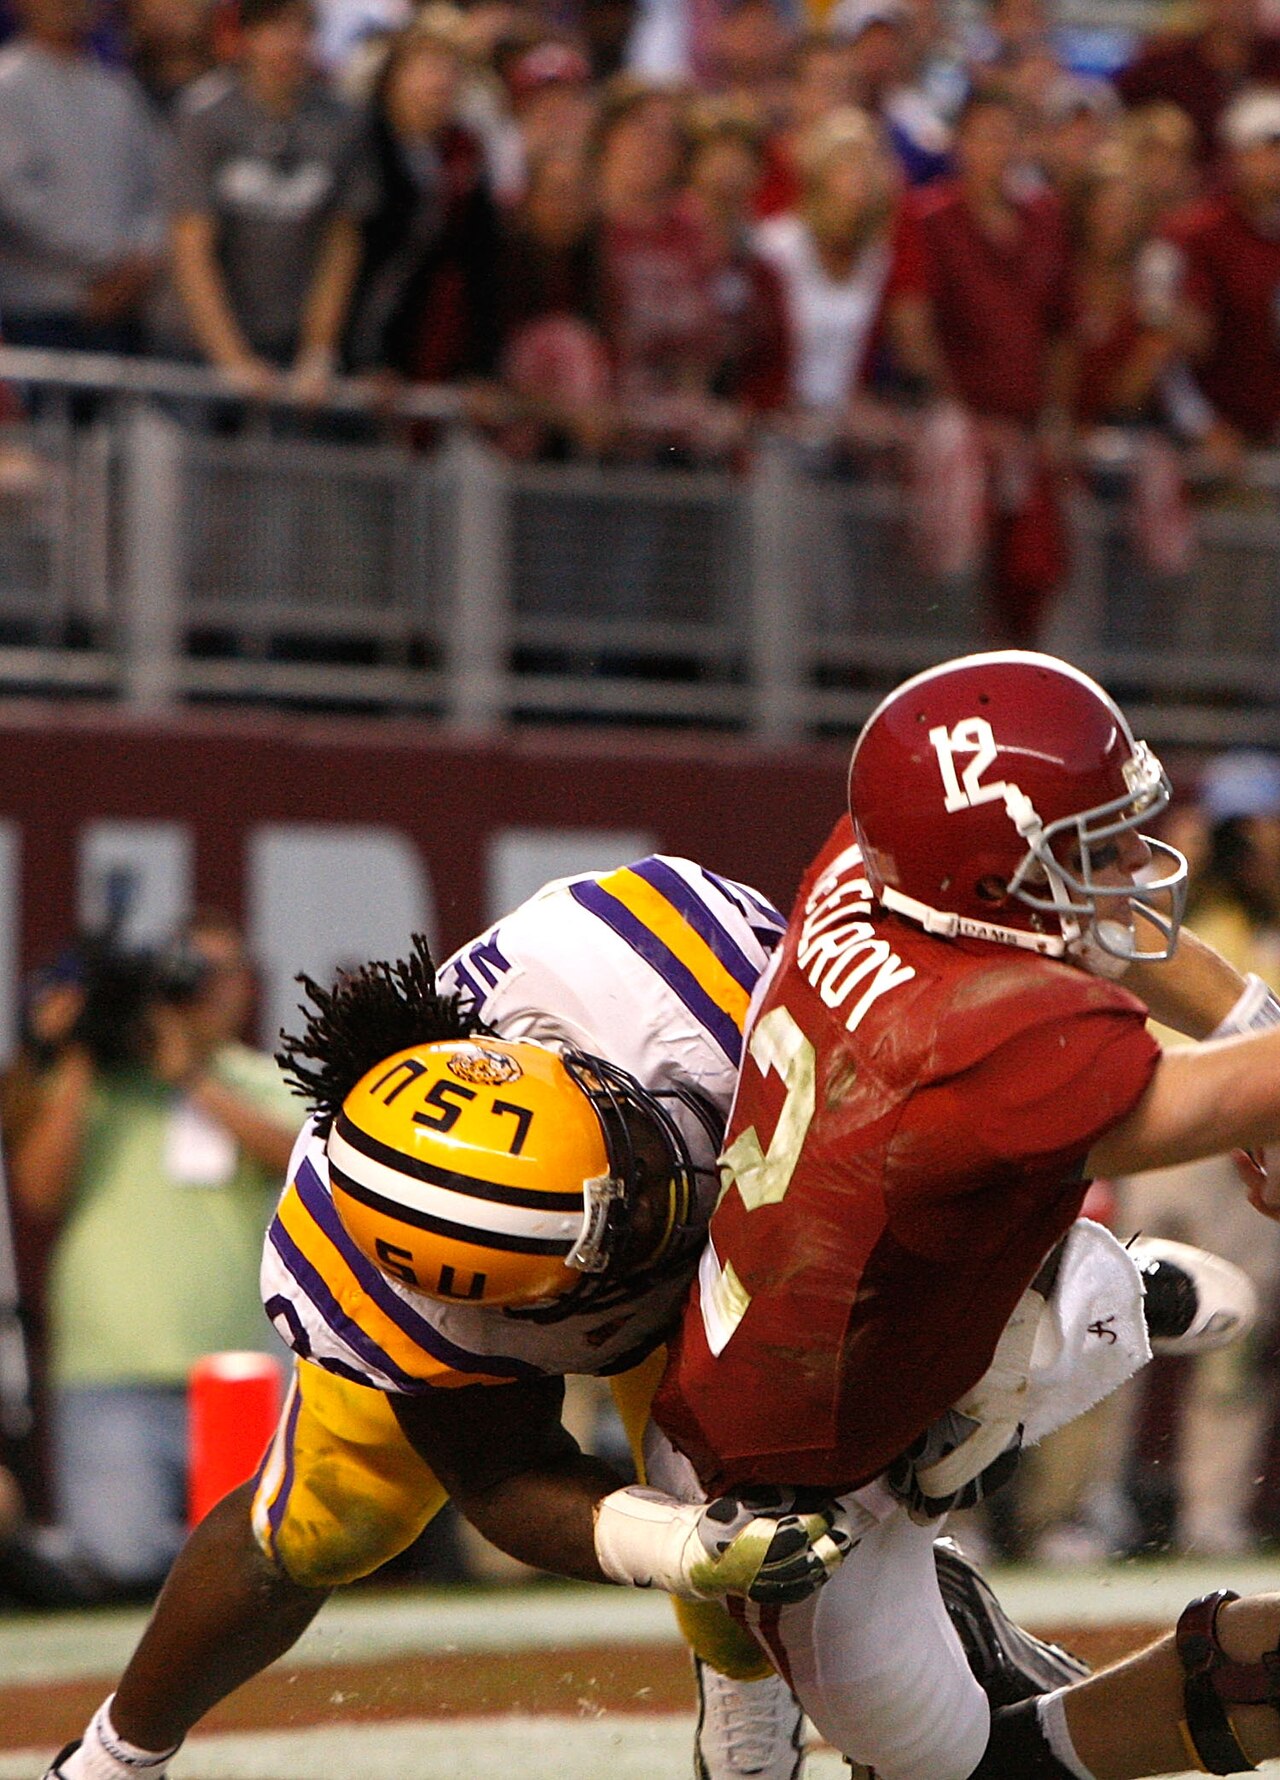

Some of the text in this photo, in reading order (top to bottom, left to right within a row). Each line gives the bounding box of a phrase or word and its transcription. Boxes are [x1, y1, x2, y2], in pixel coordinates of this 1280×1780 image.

[929, 717, 1006, 813] 12
[370, 1059, 534, 1156] LSU
[375, 1238, 487, 1300] SU
